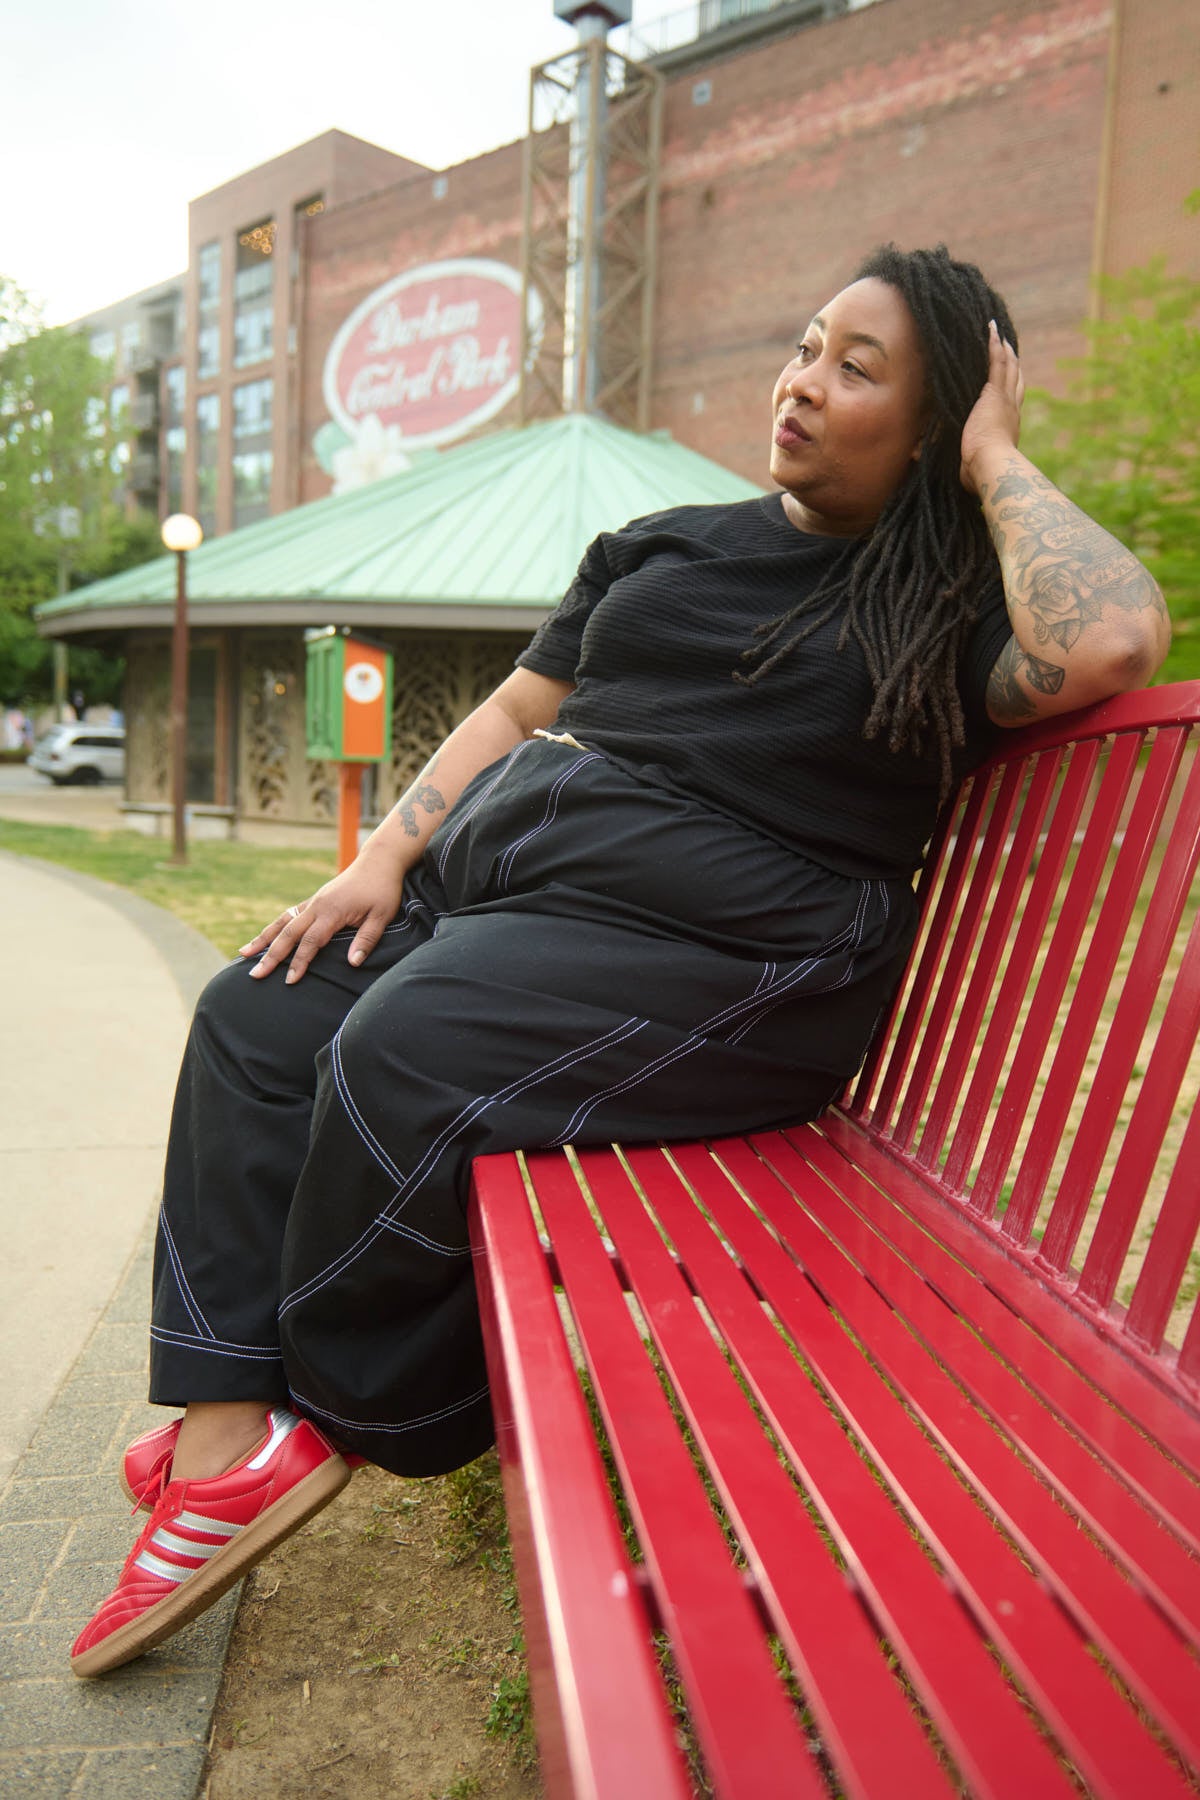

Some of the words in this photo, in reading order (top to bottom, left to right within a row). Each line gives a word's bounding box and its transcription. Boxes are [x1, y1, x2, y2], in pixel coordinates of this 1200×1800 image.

[367, 294, 480, 354] Durham
[346, 348, 445, 415] Central
[438, 335, 511, 395] Park
